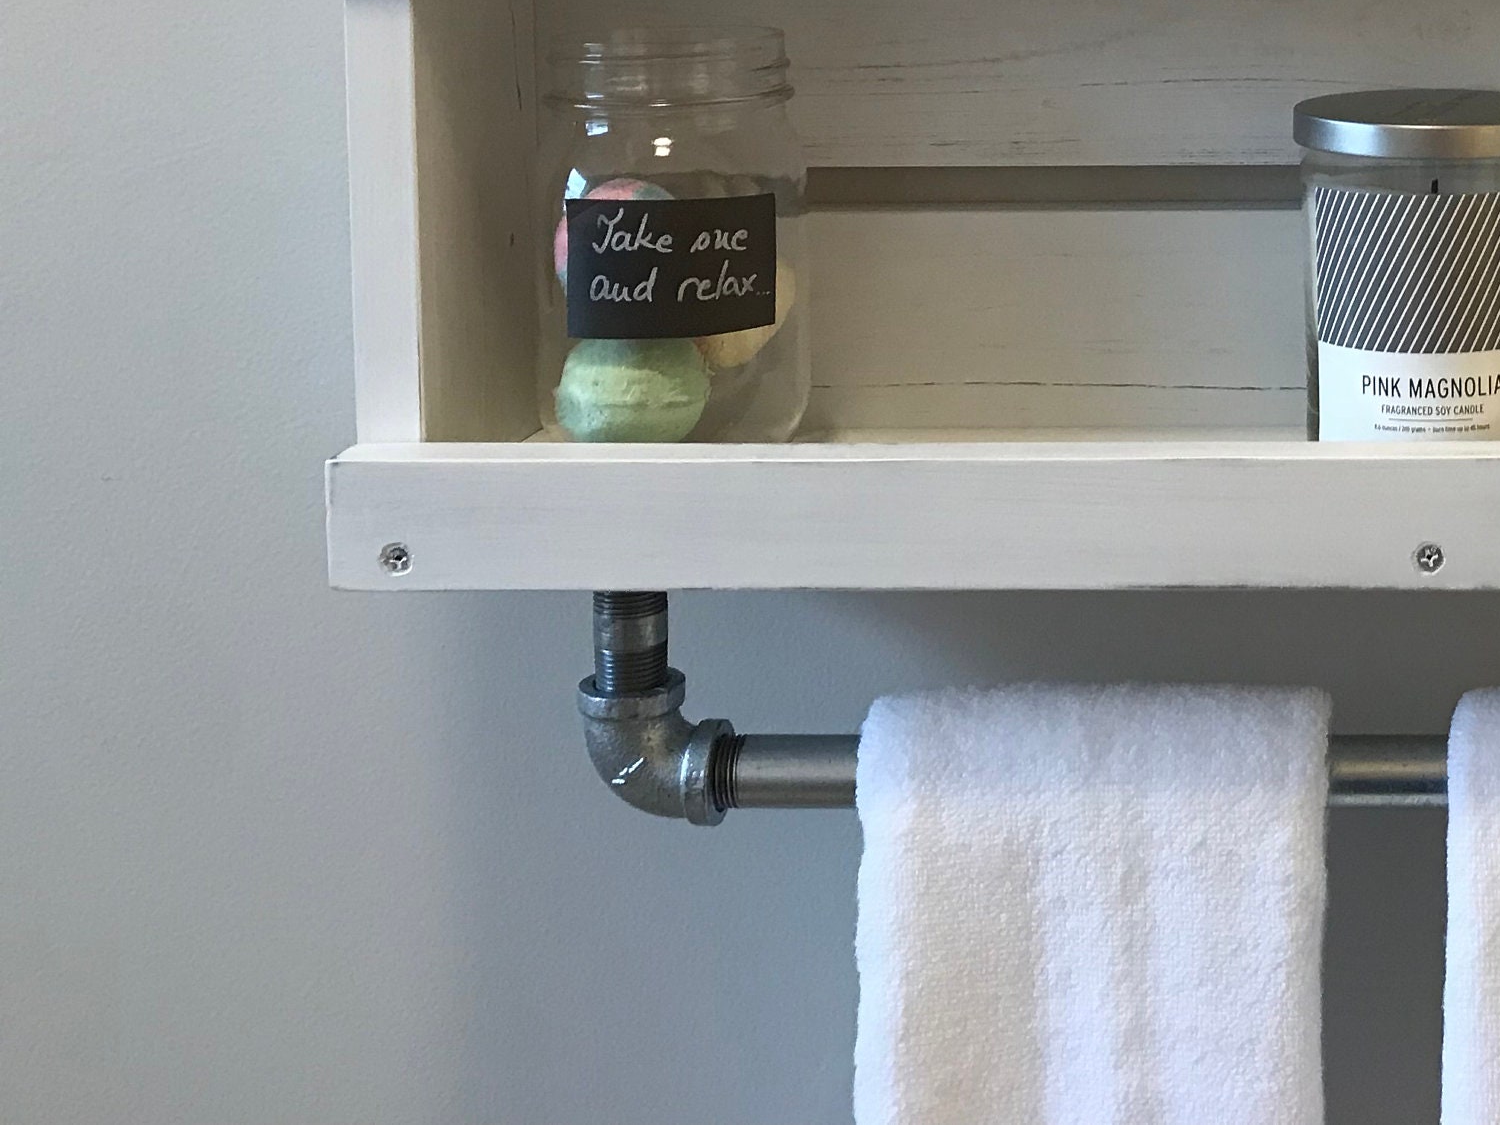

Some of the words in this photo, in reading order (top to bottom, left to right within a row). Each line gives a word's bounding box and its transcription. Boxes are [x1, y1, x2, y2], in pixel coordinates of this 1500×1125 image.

[591, 207, 673, 254] Take
[689, 228, 748, 254] one
[589, 266, 659, 303] and
[1362, 375, 1402, 398] PINK
[1381, 404, 1433, 416] FRAGRANCED
[1435, 405, 1451, 416] SOY
[1453, 403, 1484, 415] CANDLE
